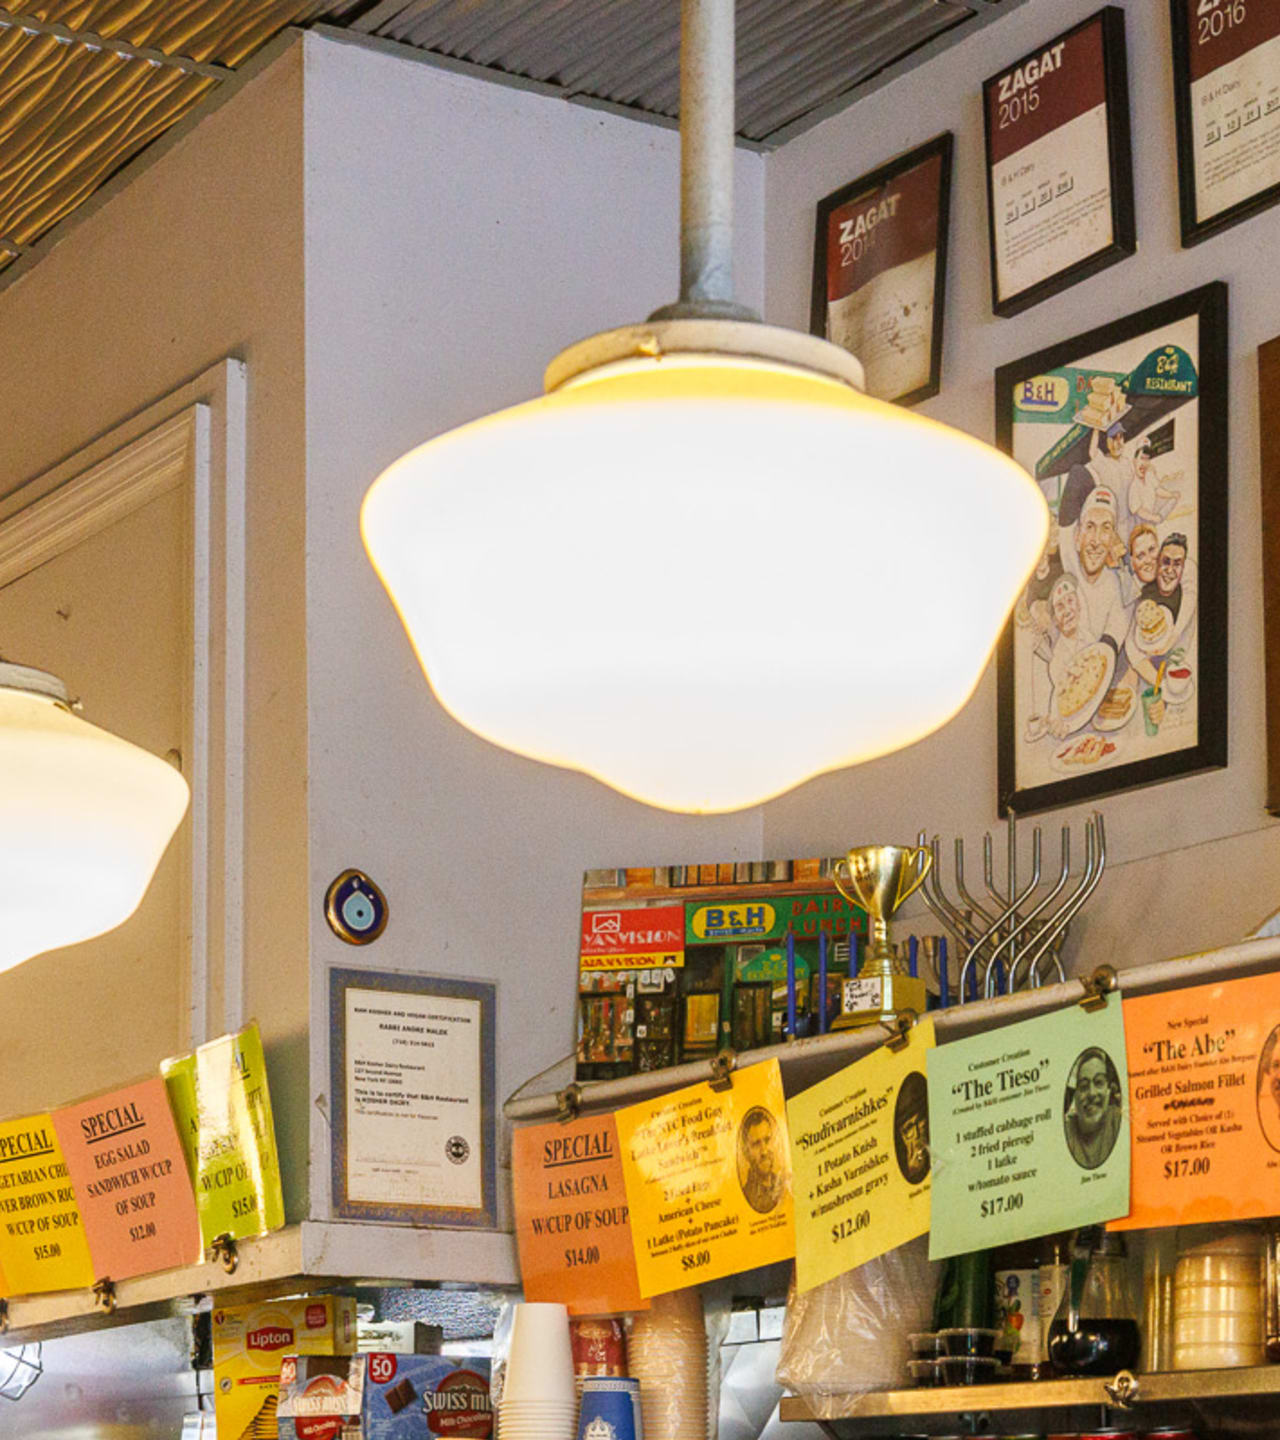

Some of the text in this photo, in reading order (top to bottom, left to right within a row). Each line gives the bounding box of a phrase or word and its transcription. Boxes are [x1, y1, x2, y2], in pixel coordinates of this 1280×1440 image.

[1197, 4, 1247, 45] 2016
[998, 43, 1065, 103] ZAGAT
[998, 86, 1041, 130] 2015
[839, 192, 901, 245] ZAGAT
[705, 905, 766, 930] B&H
[1134, 1071, 1247, 1102] Grilled Salmon Fillet
[80, 1101, 144, 1139] SPECIAL
[961, 1113, 1034, 1143] stuffed cabbage
[93, 1138, 152, 1170] EGG SALAD
[543, 1131, 613, 1164] SPECIAL
[823, 1150, 852, 1175] Potato
[851, 1136, 878, 1160] Knish
[842, 1150, 890, 1184] Varnishkes
[1162, 1156, 1212, 1180] $17.00
[85, 1170, 140, 1199] SANDWICH
[547, 1173, 609, 1201] LASAGNA
[19, 1189, 58, 1212] BROWN
[129, 1190, 157, 1213] SOUP
[980, 1192, 1024, 1219] $17.00
[592, 1204, 629, 1230] SOUP
[830, 1208, 871, 1245] $12.00
[128, 1221, 157, 1244] $12.00
[32, 1243, 62, 1262] $15.00
[564, 1245, 601, 1269] $14.00
[681, 1249, 711, 1272] $8.00
[250, 1332, 291, 1347] Lipton
[372, 1358, 393, 1377] 50
